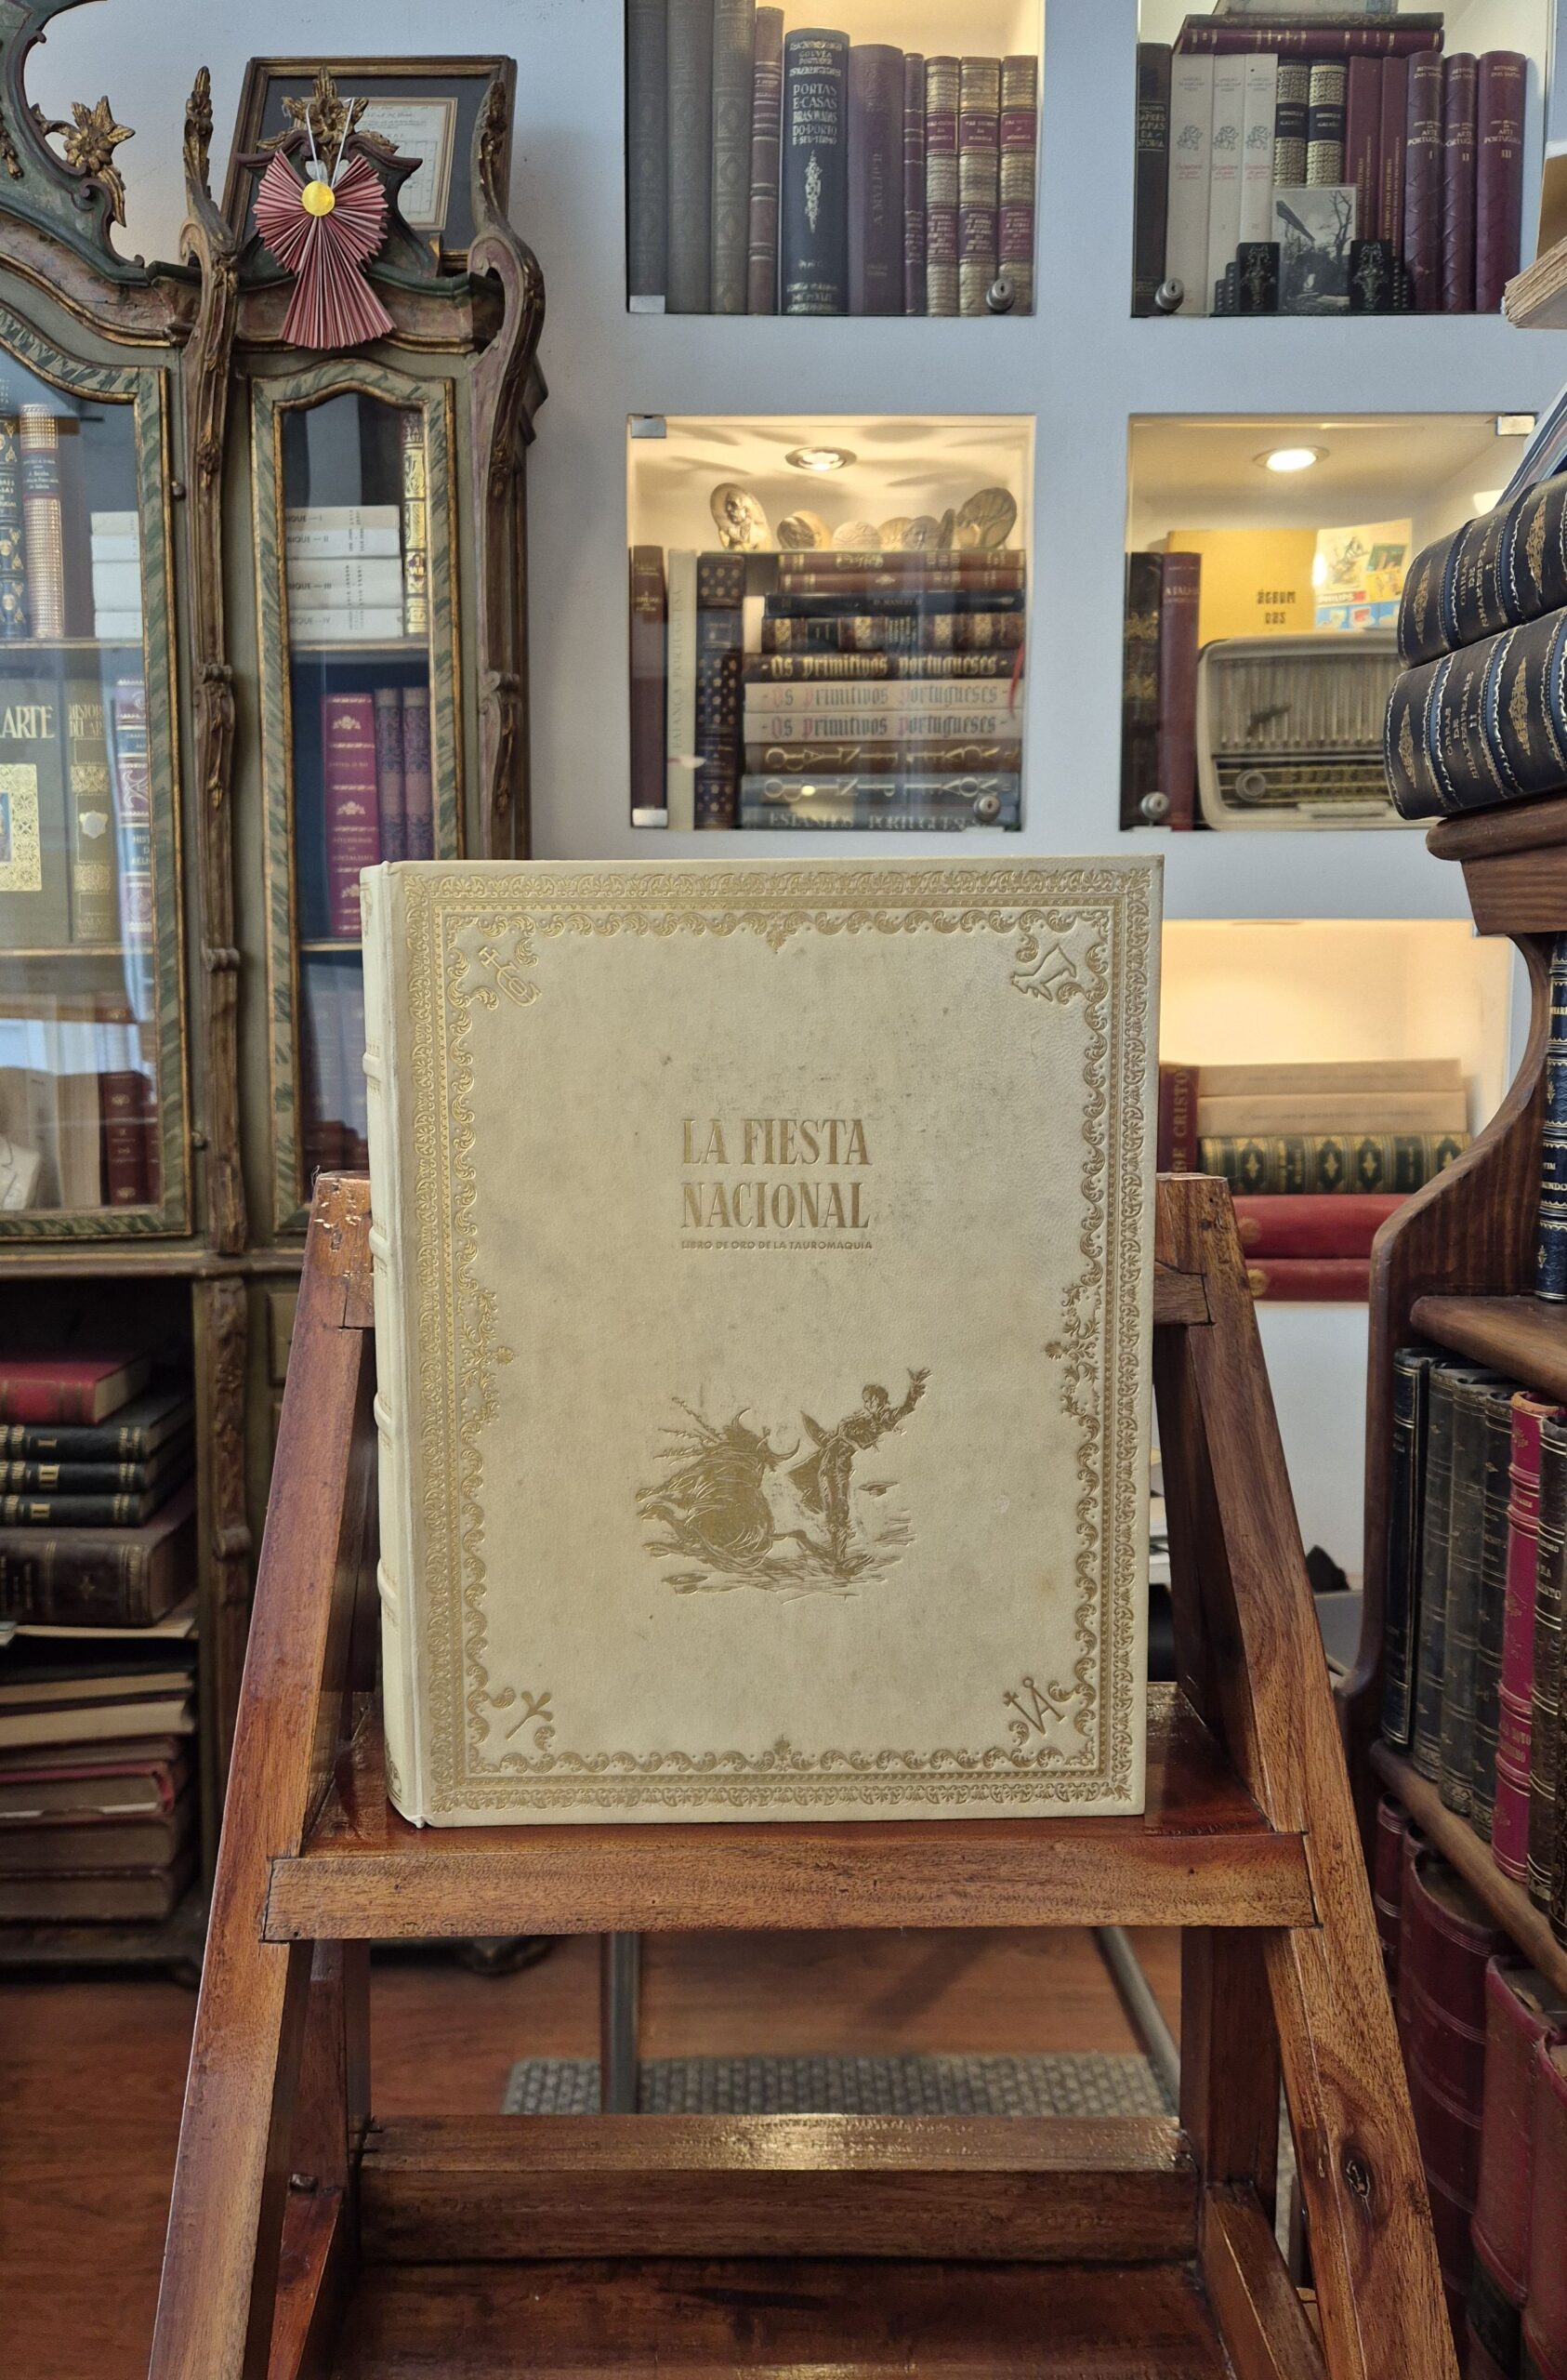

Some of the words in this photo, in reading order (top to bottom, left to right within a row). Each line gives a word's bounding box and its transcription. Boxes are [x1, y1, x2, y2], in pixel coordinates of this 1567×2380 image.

[793, 83, 836, 96] PORTAS
[1468, 566, 1476, 588] DE
[1444, 707, 1454, 756] OBRAS
[1453, 719, 1460, 739] DE
[1460, 670, 1480, 779] SHAKESPEARE
[1173, 1070, 1189, 1139] CRISTO
[682, 1118, 731, 1165] LA
[741, 1118, 873, 1165] FIESTA
[680, 1182, 872, 1229] NACIONAL
[681, 1240, 713, 1250] LIBRO
[716, 1240, 729, 1250] DE
[731, 1240, 756, 1250] ORO
[758, 1240, 771, 1250] DE
[773, 1240, 786, 1250] LA
[789, 1240, 874, 1251] TAUROMAQUIA
